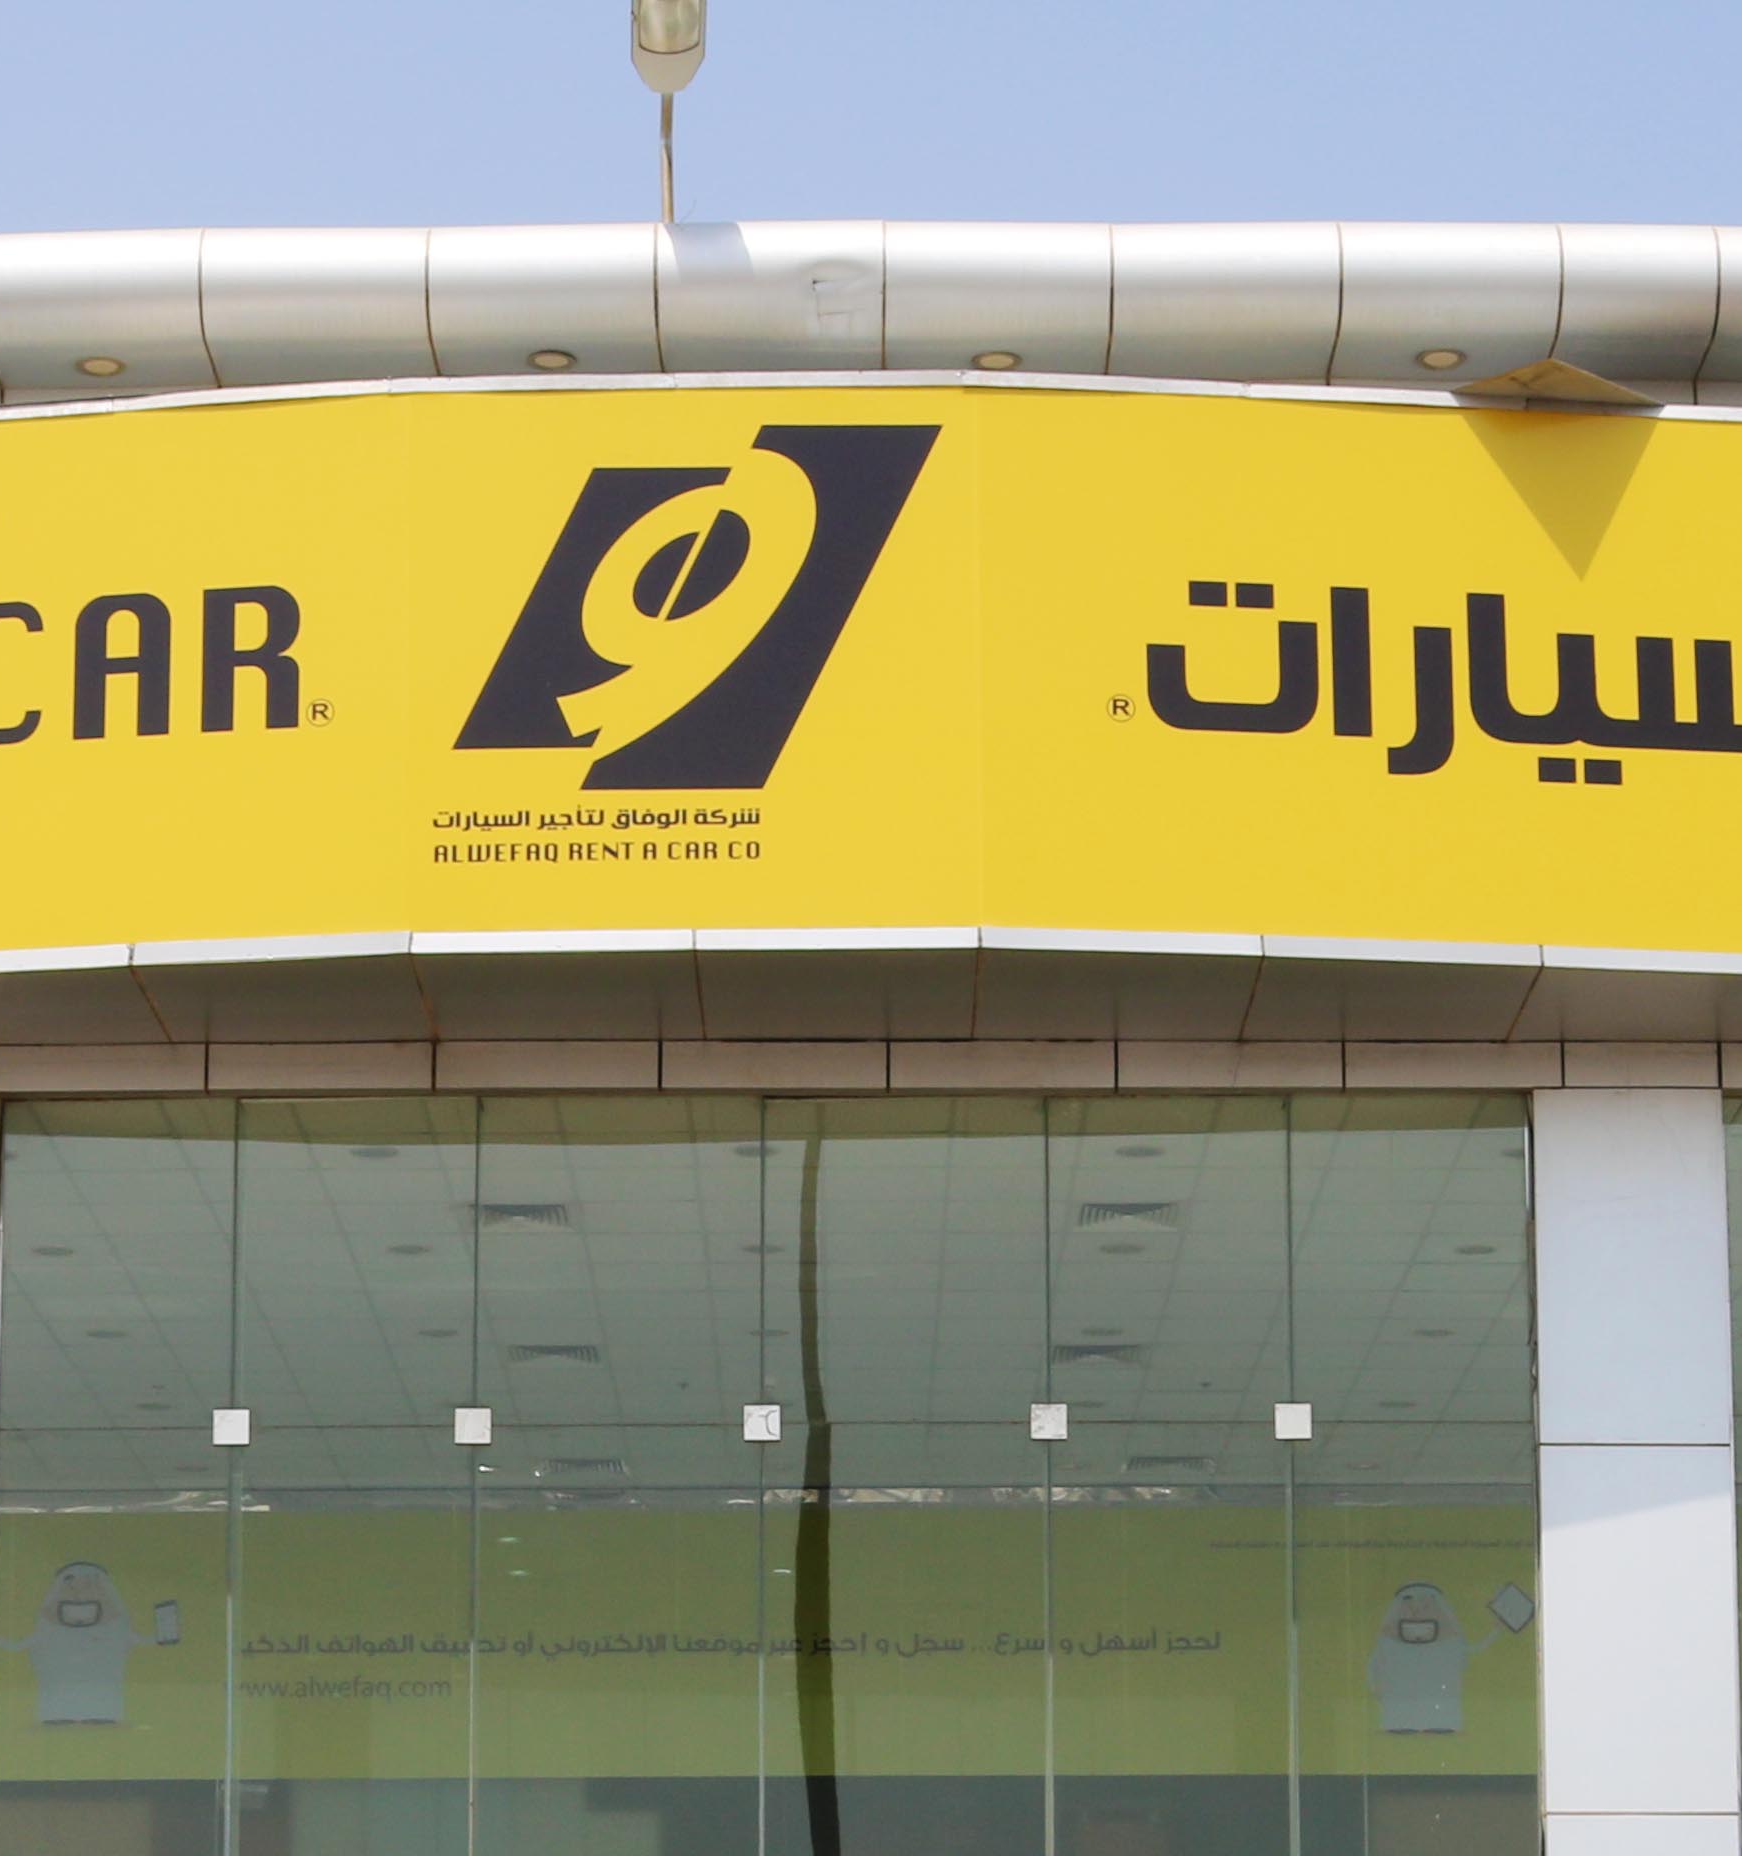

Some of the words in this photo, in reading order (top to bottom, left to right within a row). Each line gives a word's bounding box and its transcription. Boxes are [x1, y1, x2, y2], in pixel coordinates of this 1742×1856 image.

[432, 809, 530, 832] السيارات
[537, 805, 605, 831] لتأجير
[611, 808, 687, 830] الوفاق
[693, 808, 760, 828] شركة
[433, 843, 558, 863] ALWEFAQ
[569, 842, 635, 860] RENT
[643, 842, 657, 860] A
[667, 841, 718, 860] CAR
[728, 841, 760, 859] CO
